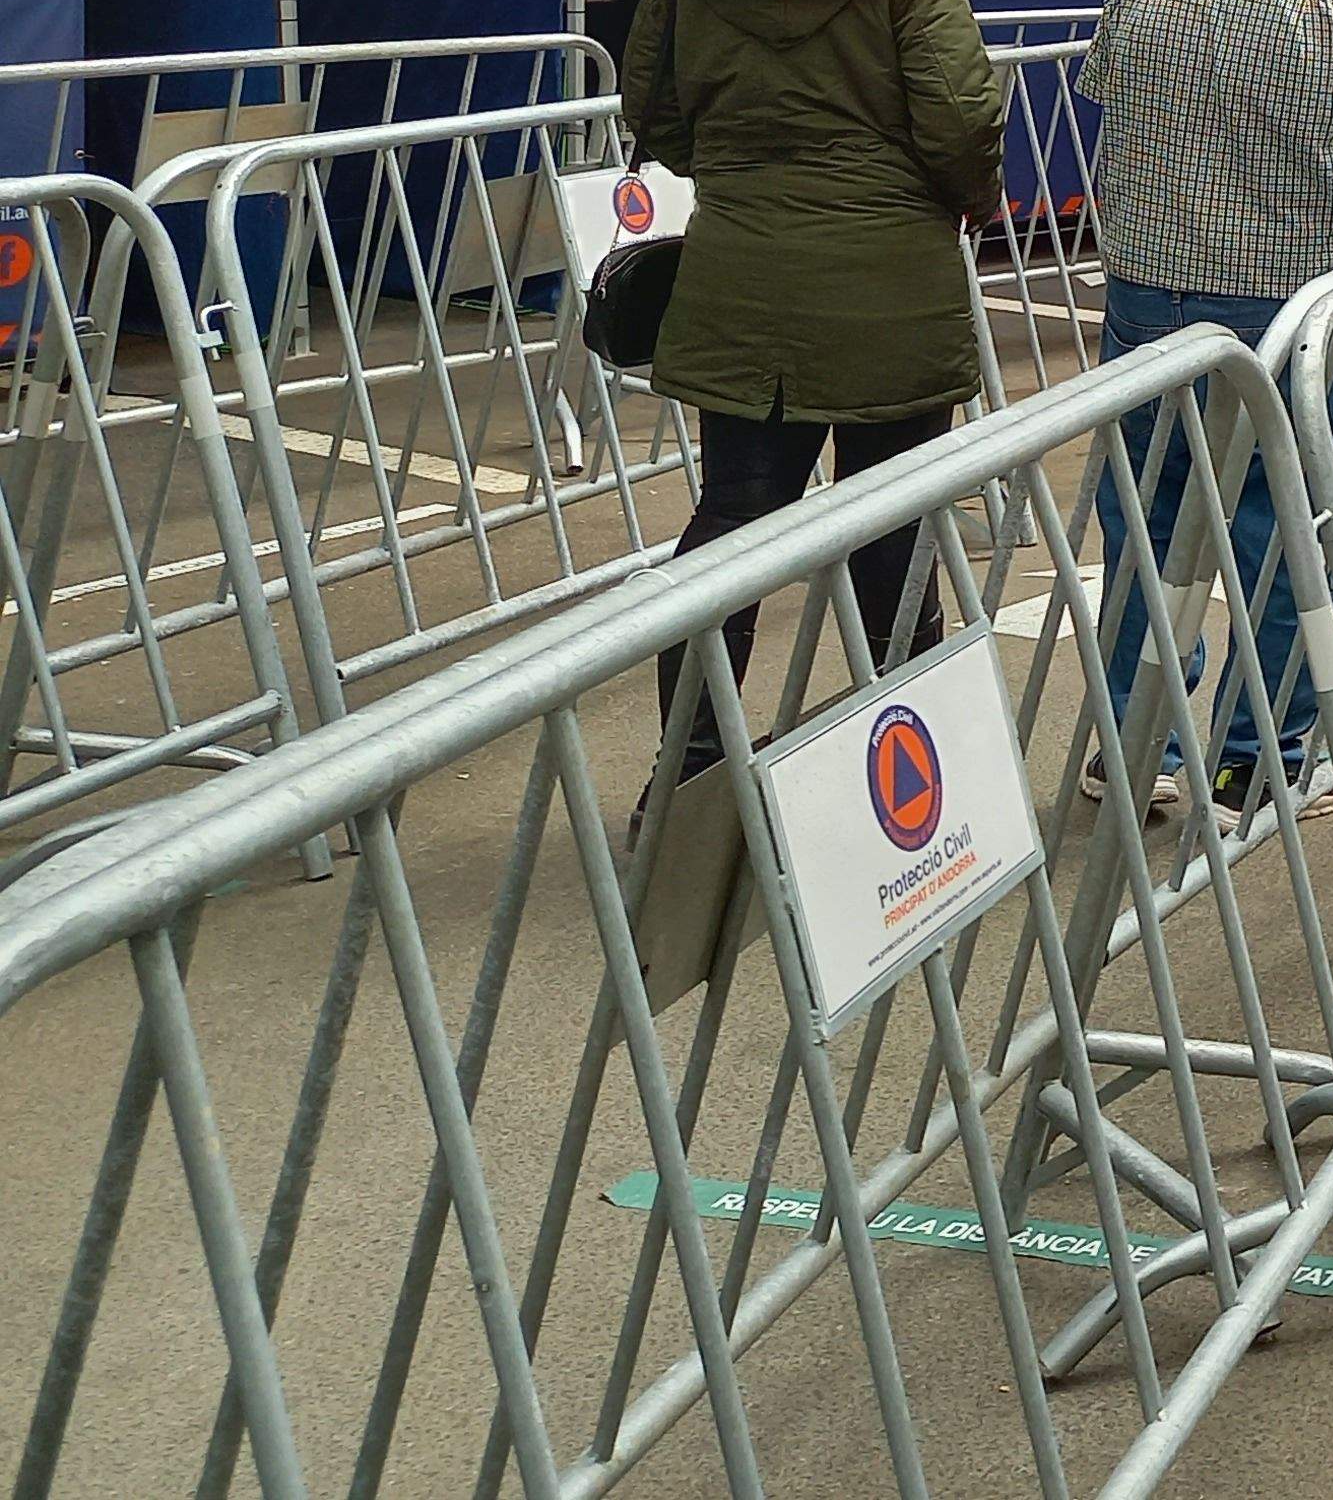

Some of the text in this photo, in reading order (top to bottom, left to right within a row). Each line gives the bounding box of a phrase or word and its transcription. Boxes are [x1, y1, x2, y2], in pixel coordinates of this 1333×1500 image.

[878, 822, 972, 909] Protecció Civil
[883, 886, 928, 930] PRINCIPAT
[893, 1215, 938, 1235] LA
